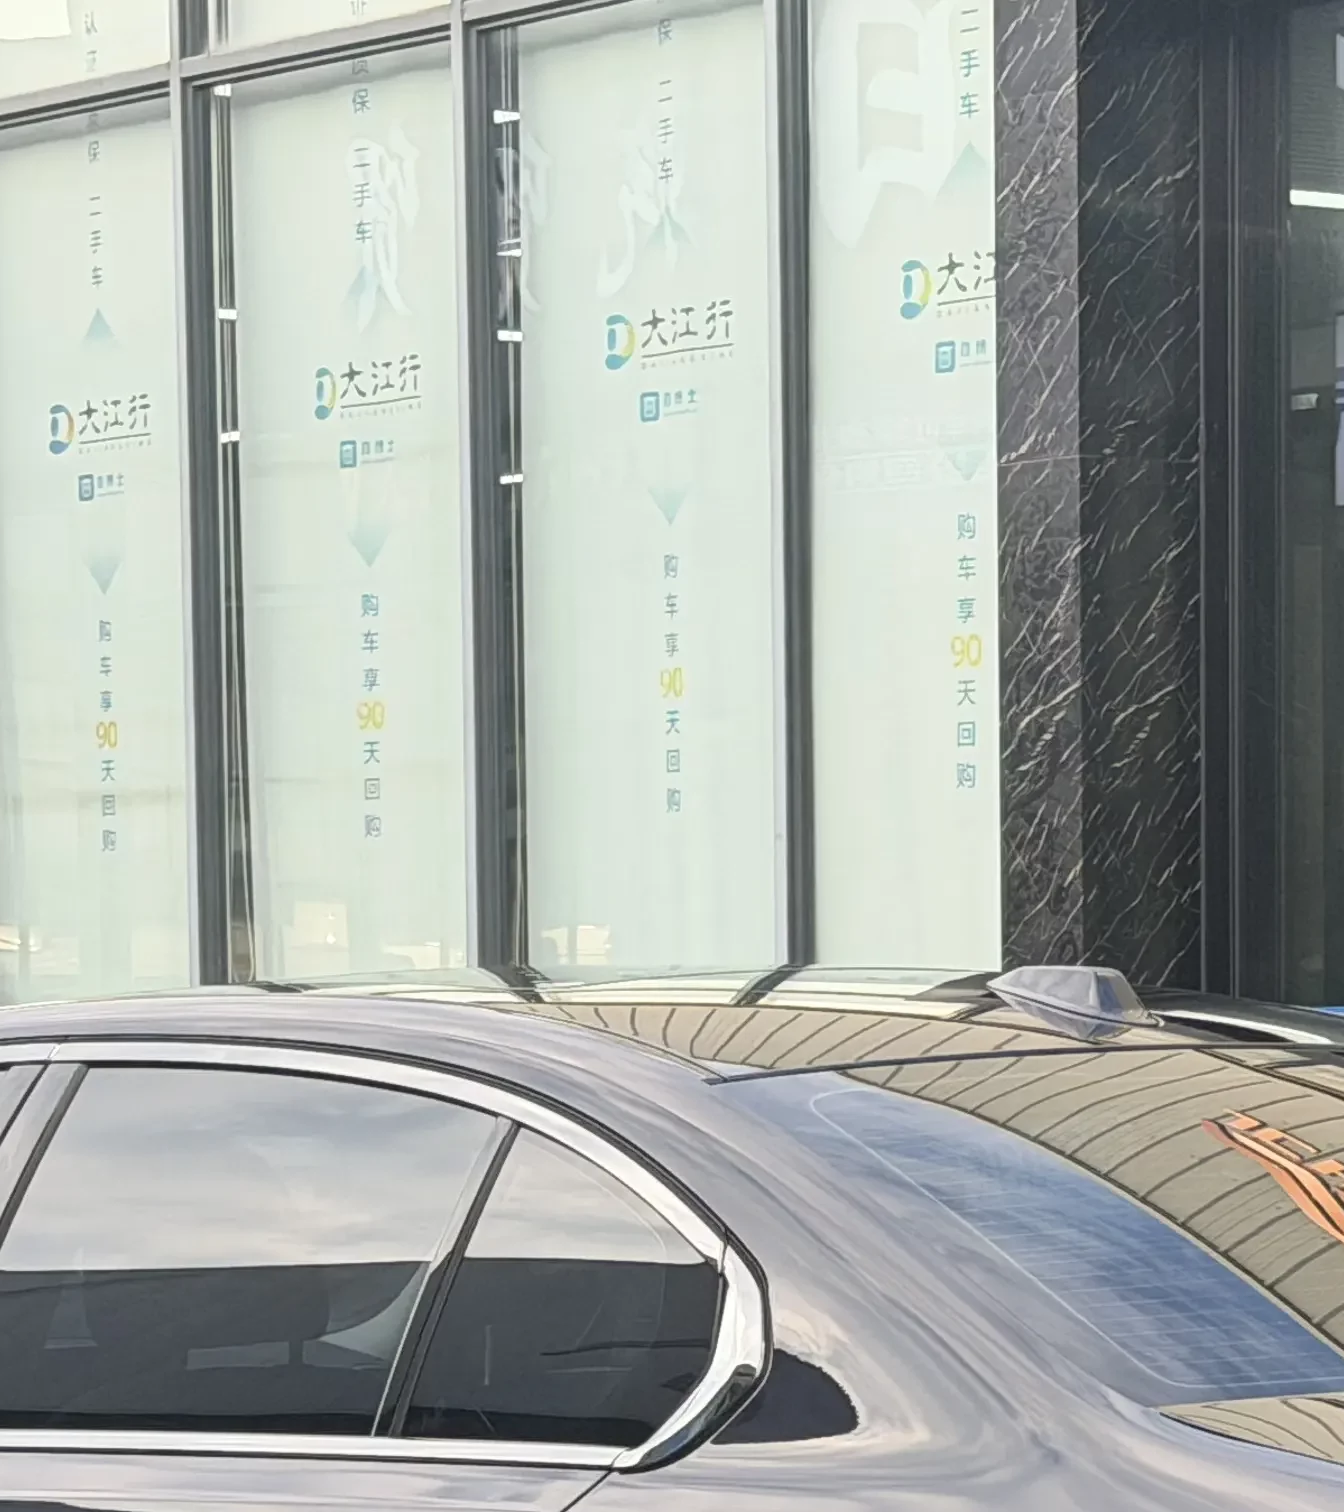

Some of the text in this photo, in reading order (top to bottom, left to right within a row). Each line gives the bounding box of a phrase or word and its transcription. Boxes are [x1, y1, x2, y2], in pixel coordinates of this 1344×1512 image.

[959, 8, 980, 119] 二手车
[657, 79, 675, 184] 二手车
[353, 147, 373, 244] 二手车
[640, 299, 734, 349] 大江行
[339, 353, 422, 400] 大江行
[78, 393, 151, 436] 大江行
